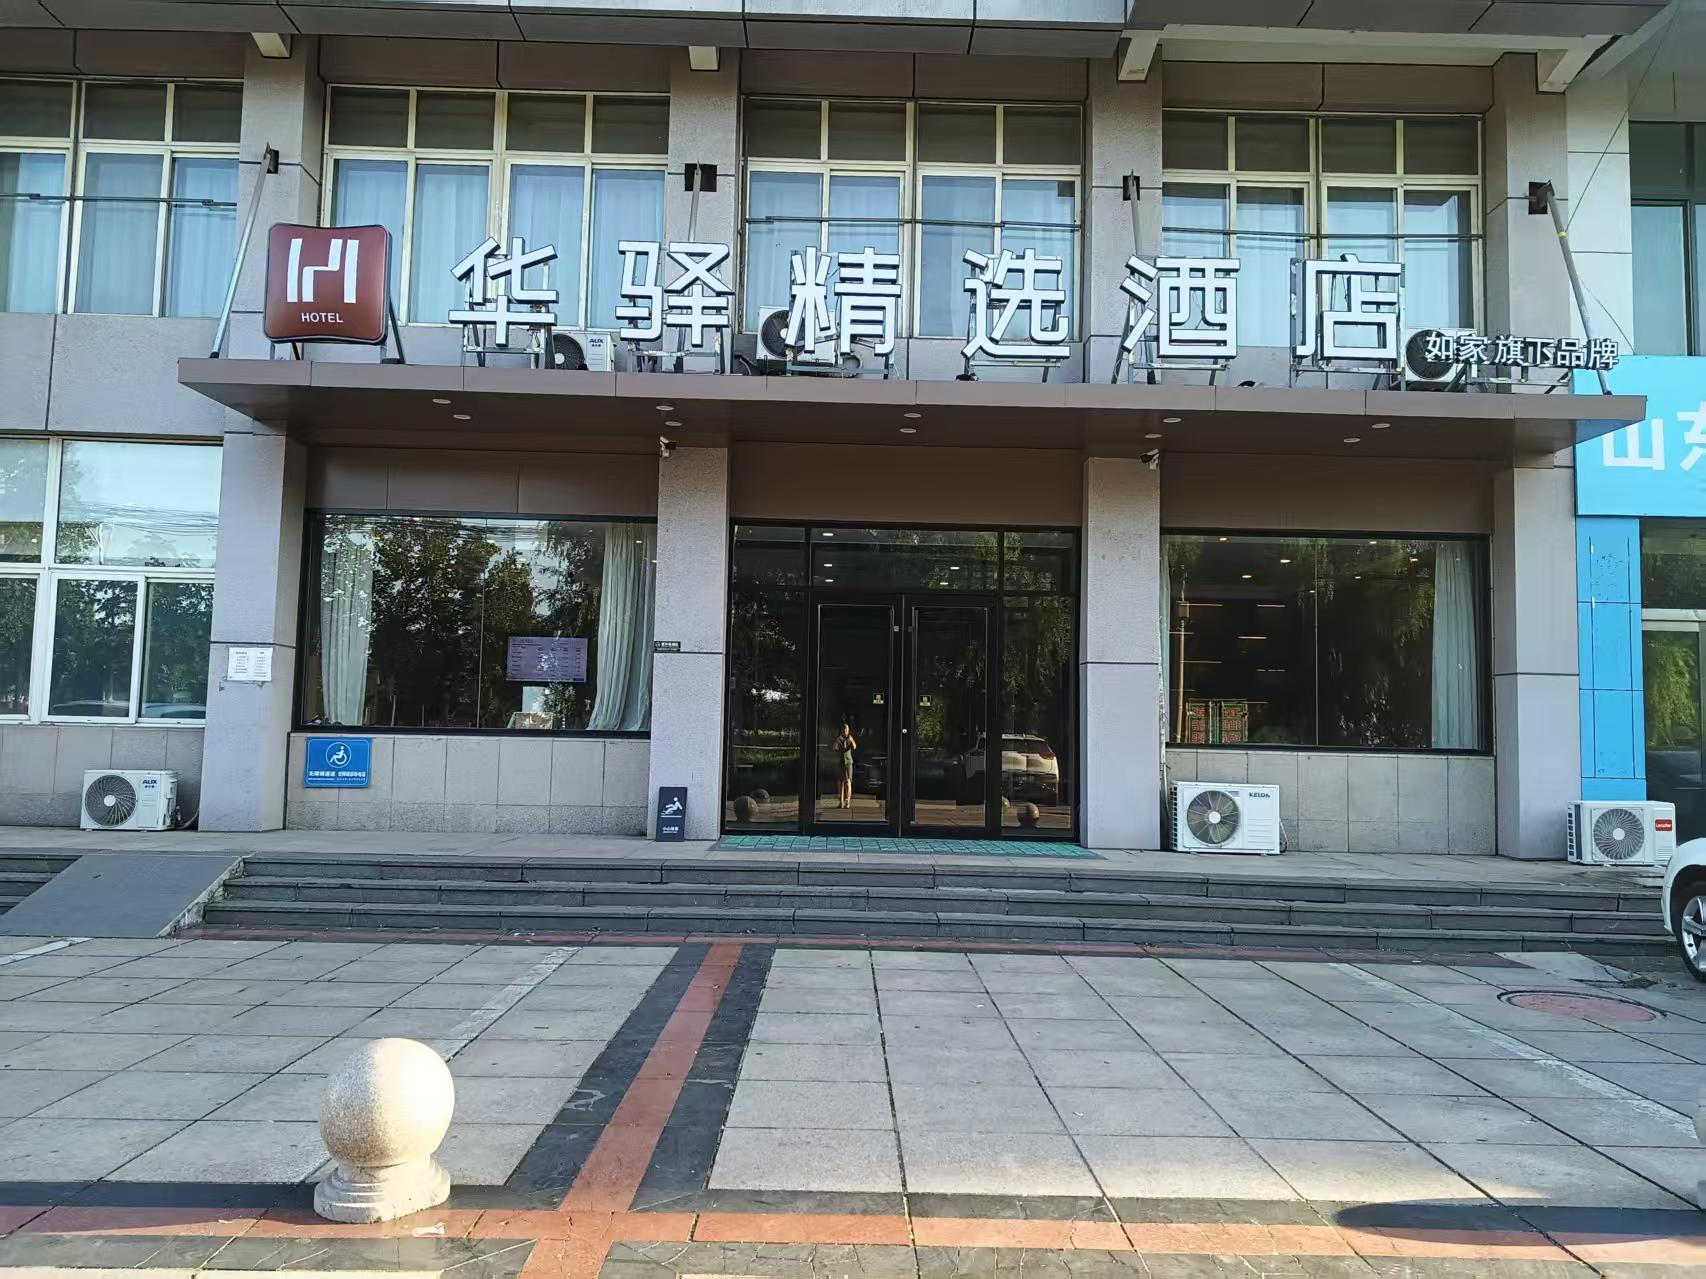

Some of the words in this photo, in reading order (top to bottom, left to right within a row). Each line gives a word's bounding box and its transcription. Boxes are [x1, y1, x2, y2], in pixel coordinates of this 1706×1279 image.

[301, 312, 344, 323] HOTEL
[448, 236, 1402, 361] 华驿精选酒店
[1424, 331, 1619, 370] 如家旗下品牌
